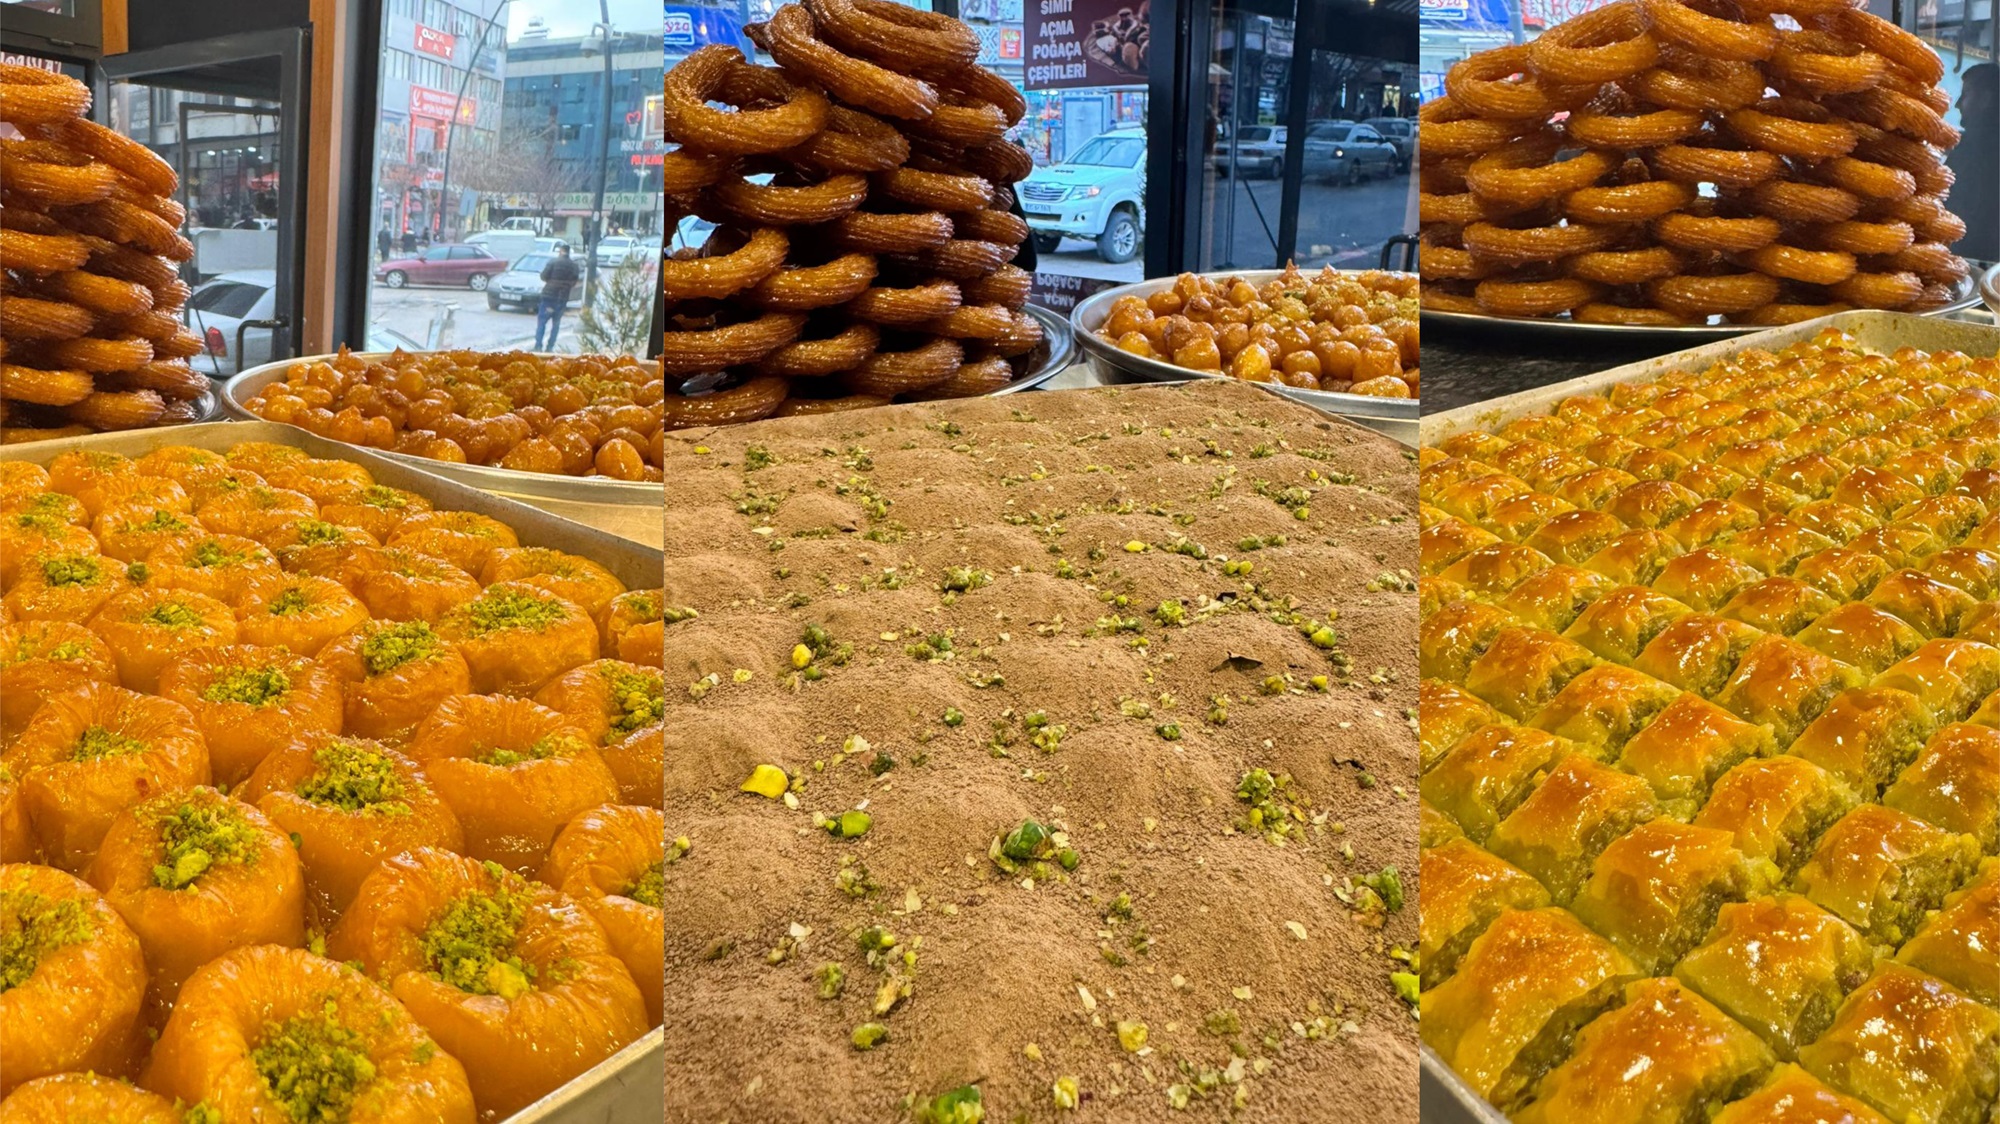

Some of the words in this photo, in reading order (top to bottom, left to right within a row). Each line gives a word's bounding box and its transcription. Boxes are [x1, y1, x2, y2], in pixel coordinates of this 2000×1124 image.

[1039, 19, 1074, 41] AÇMA
[1032, 40, 1082, 61] POĞAÇA
[1027, 59, 1087, 86] ÇEŞİTLERİ
